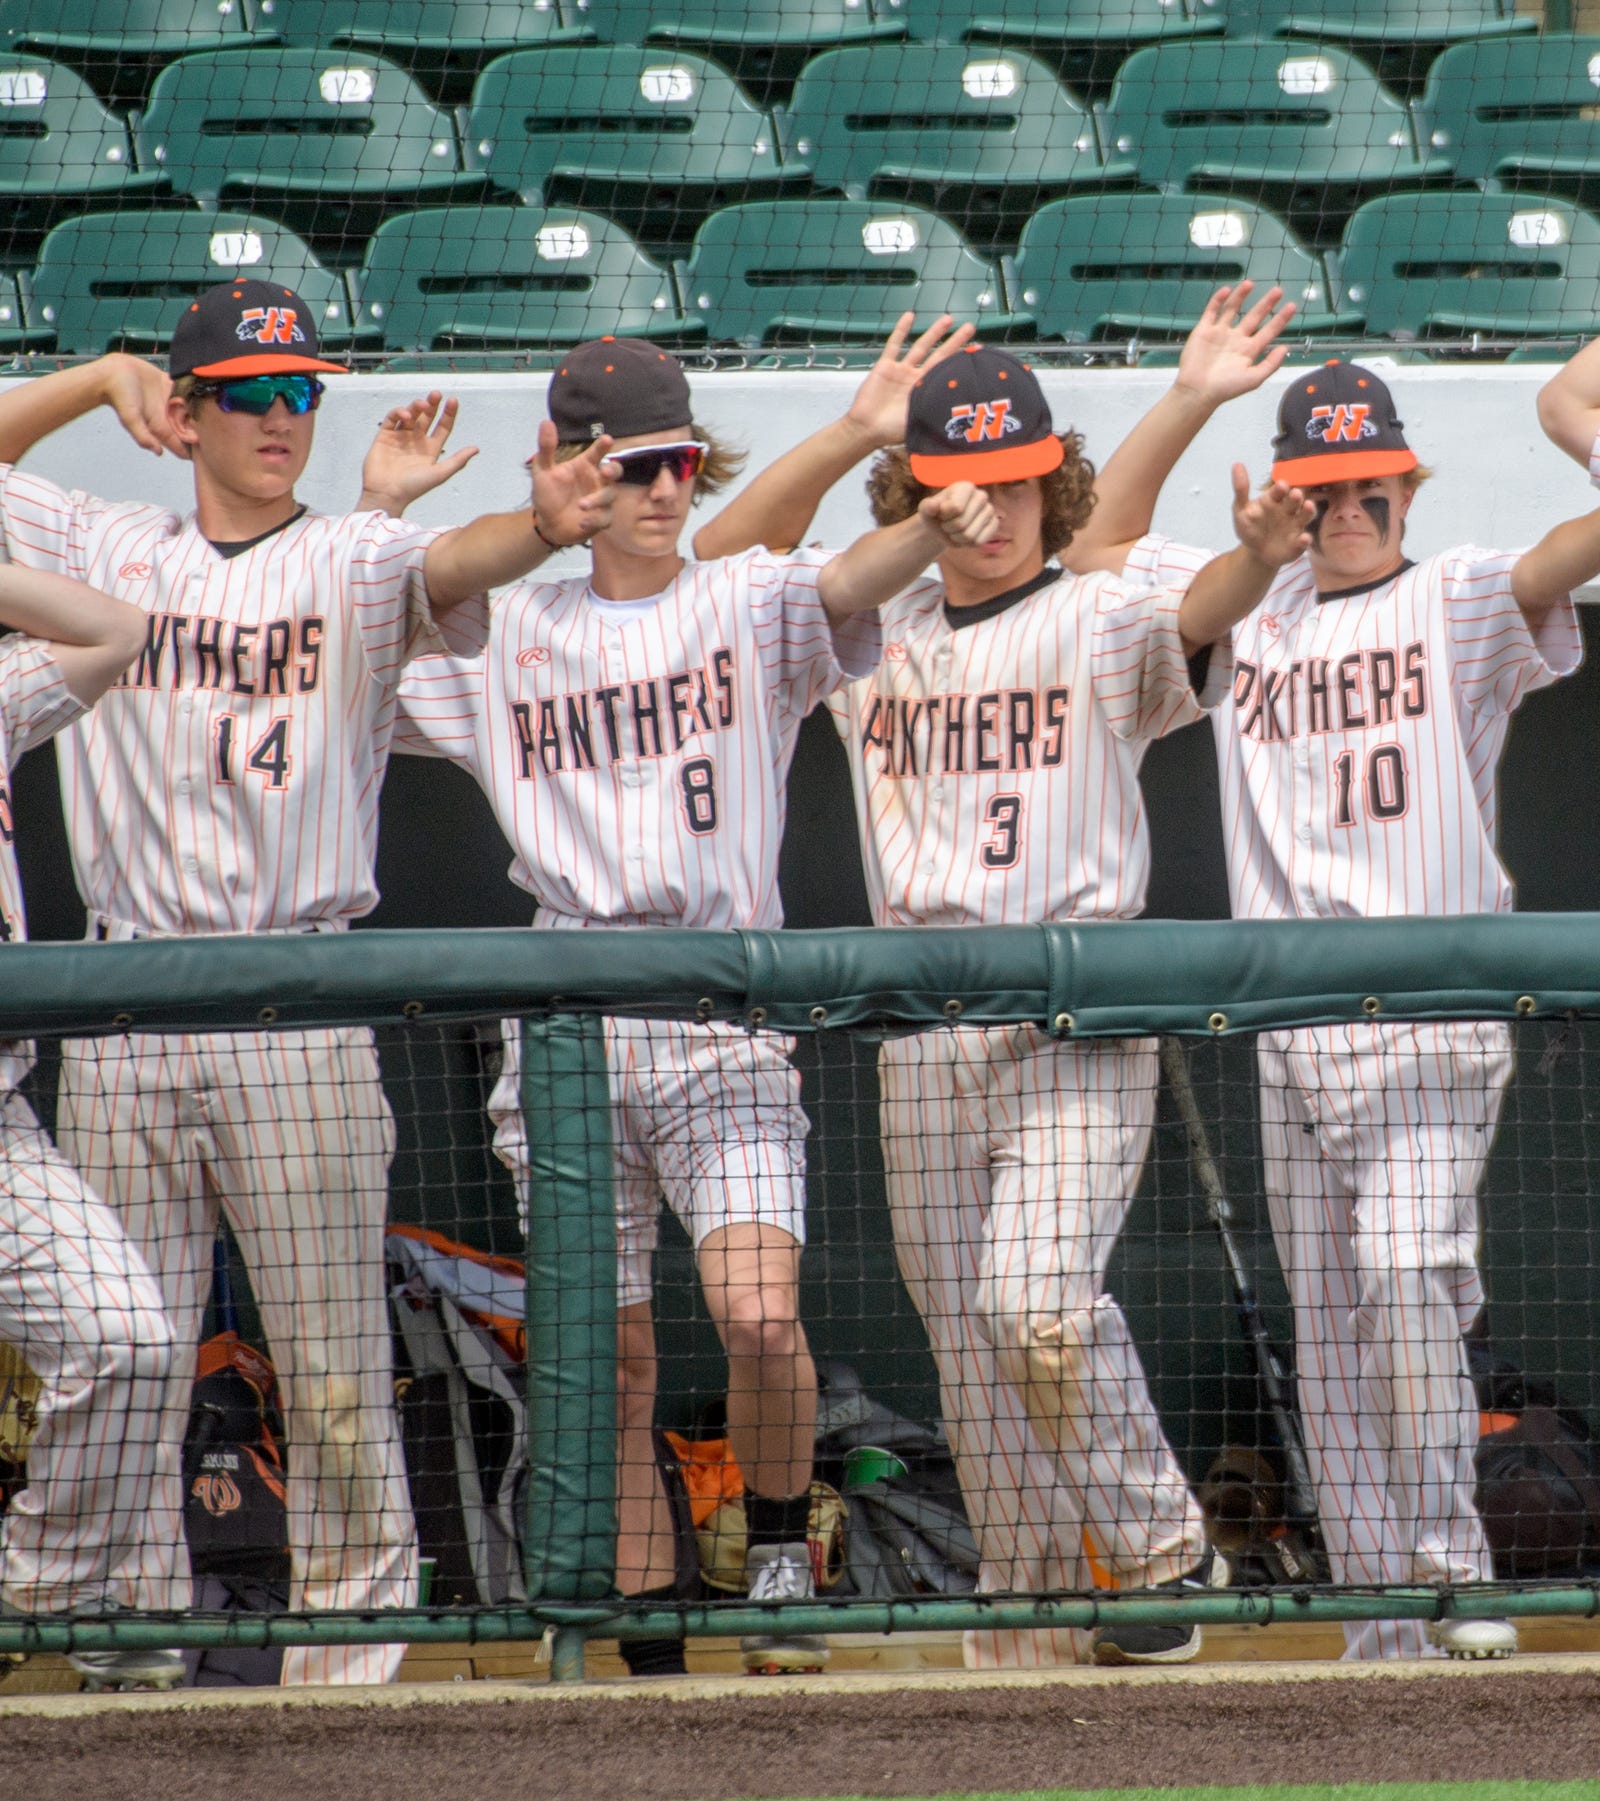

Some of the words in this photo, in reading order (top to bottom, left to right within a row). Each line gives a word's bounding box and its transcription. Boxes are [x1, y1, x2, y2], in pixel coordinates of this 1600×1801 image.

[334, 75, 361, 98] 12
[223, 236, 246, 258] 11
[877, 225, 903, 247] 13
[1521, 218, 1548, 241] 15
[110, 611, 326, 696] NTHERS
[214, 712, 293, 790] 14
[862, 684, 1072, 780] ANTHERS
[680, 753, 719, 837] 8
[1333, 741, 1410, 828] 10
[979, 791, 1024, 870] 3
